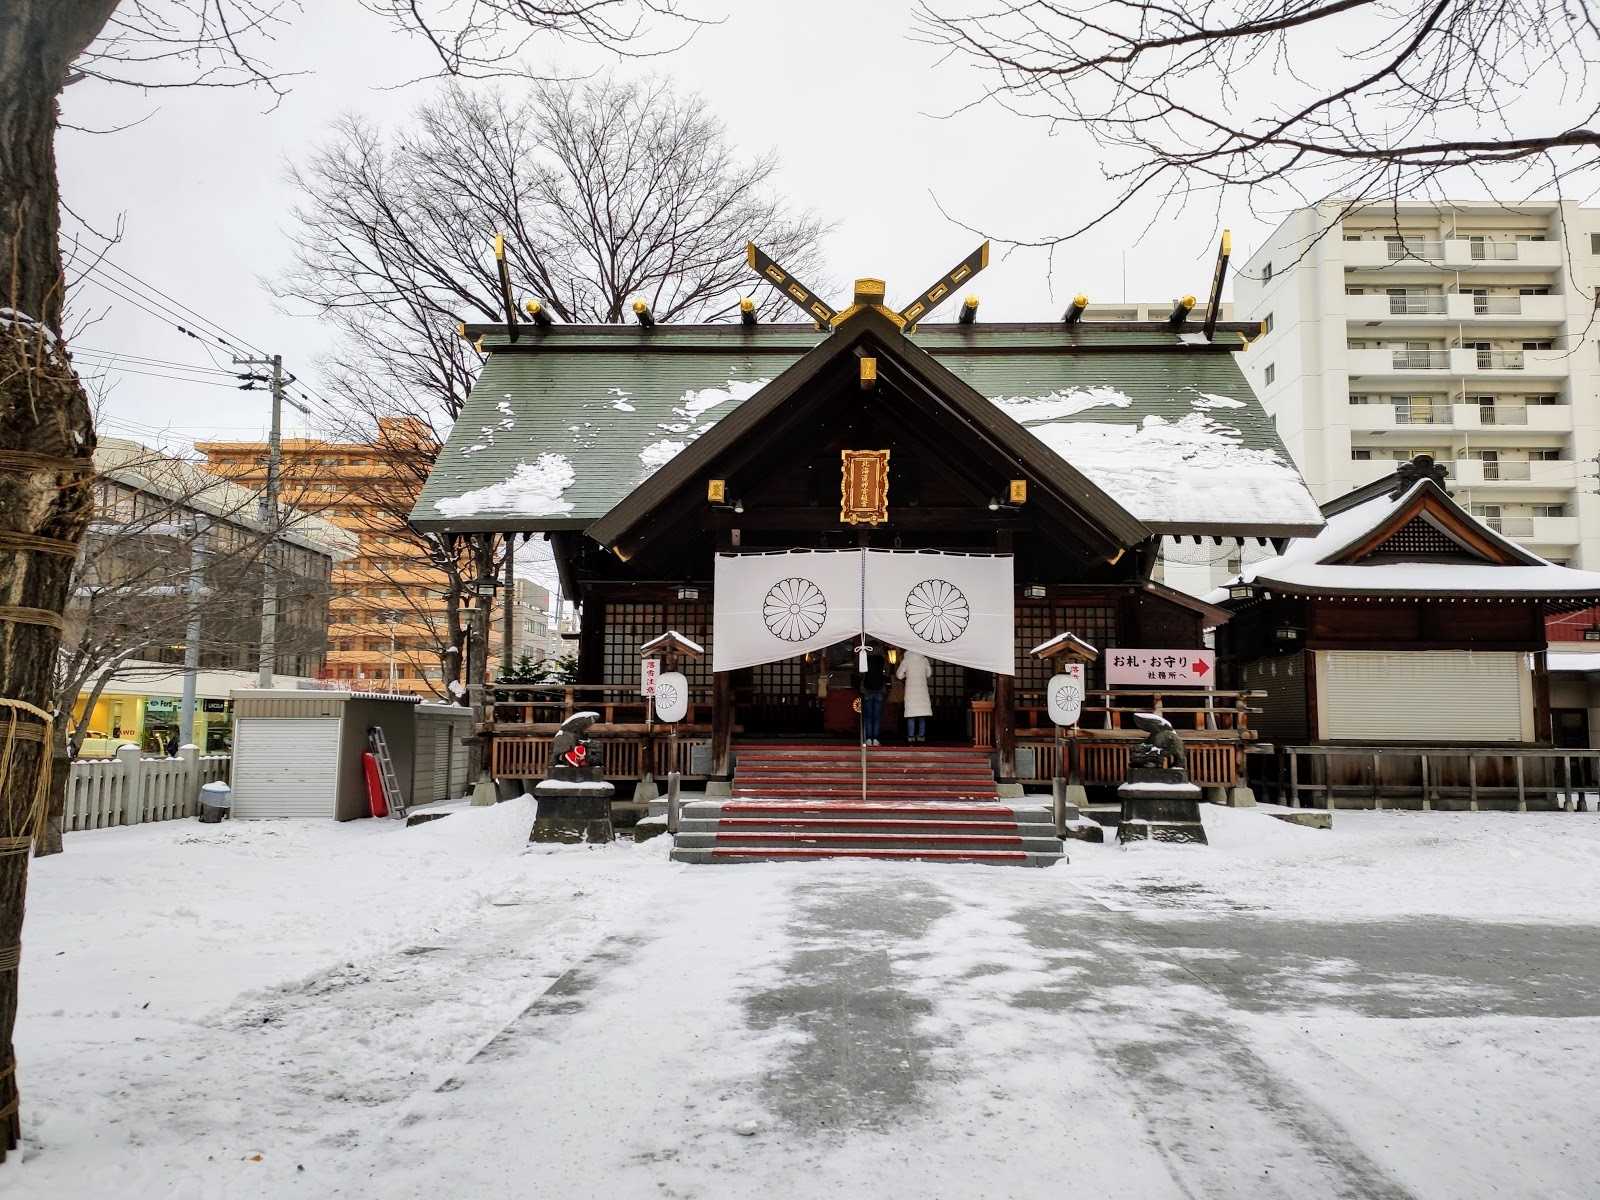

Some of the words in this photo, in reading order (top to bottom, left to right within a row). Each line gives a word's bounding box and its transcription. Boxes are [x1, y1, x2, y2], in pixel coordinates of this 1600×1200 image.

[1113, 655, 1187, 668] お札・お守り
[1148, 671, 1188, 680] 社務所へ
